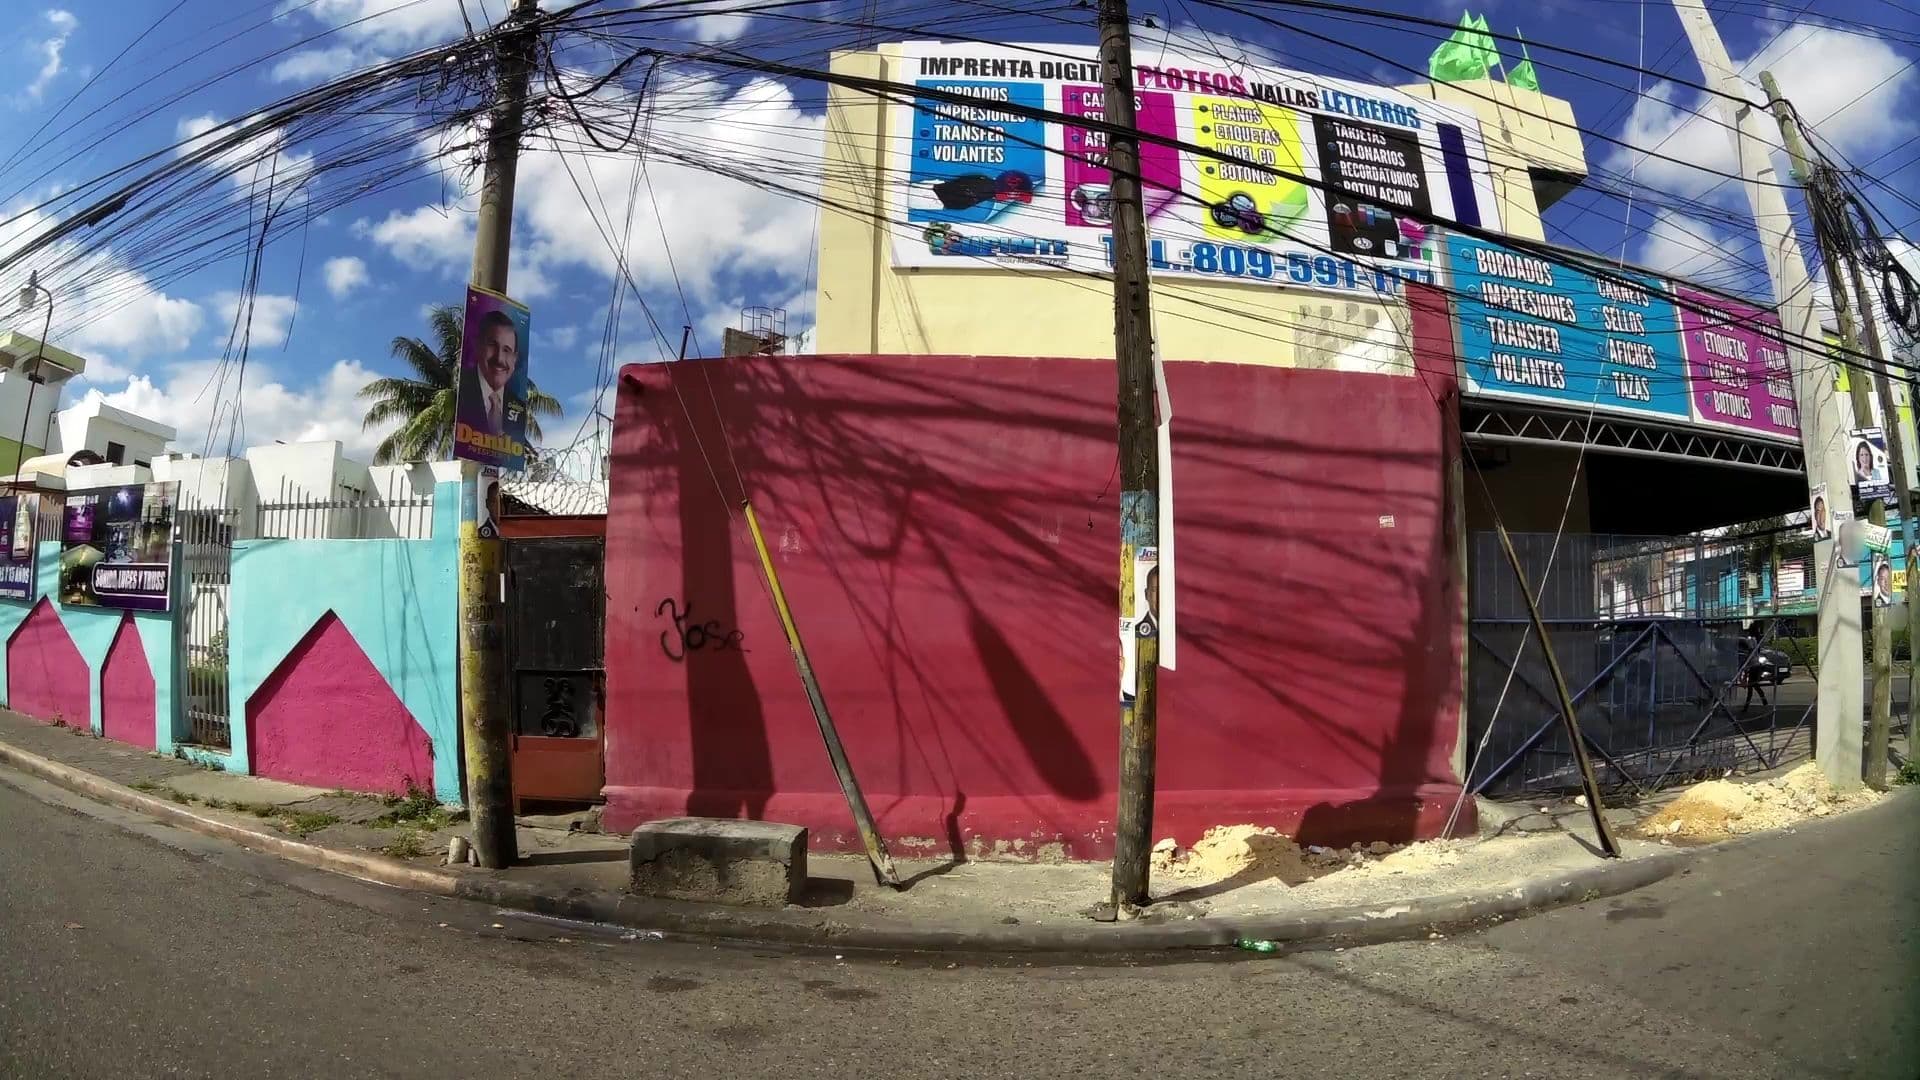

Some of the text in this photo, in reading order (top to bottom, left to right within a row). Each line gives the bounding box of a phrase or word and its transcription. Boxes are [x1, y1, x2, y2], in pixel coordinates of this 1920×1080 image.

[920, 57, 1421, 129] IMPRENTA DIGIT PLOTEOS VALLAS LETREROS
[1212, 104, 1262, 124] PLANOS
[934, 125, 1005, 142] TRANSFER
[1214, 123, 1281, 147] ETIQUETAS
[933, 145, 1005, 163] VOLANTES
[1335, 140, 1406, 168] TALONARIOS
[1219, 163, 1277, 186] BOTONES
[1339, 160, 1420, 189] RECORDATORIOS
[1343, 180, 1414, 208] ROTULACION
[1475, 247, 1553, 286] BORDADOS
[1481, 281, 1577, 323] IMPRESIONES
[1597, 273, 1650, 308] CARNETS
[1486, 316, 1561, 354] TRANSFER
[1602, 305, 1645, 337] SELLOS
[1608, 338, 1657, 370] AFICHES
[1703, 331, 1749, 363] ETIQUETAS
[1491, 352, 1566, 390] VOLANTES
[1612, 371, 1651, 402] TAZAS
[1713, 390, 1753, 420] BOTONES
[456, 422, 523, 457] Danilo
